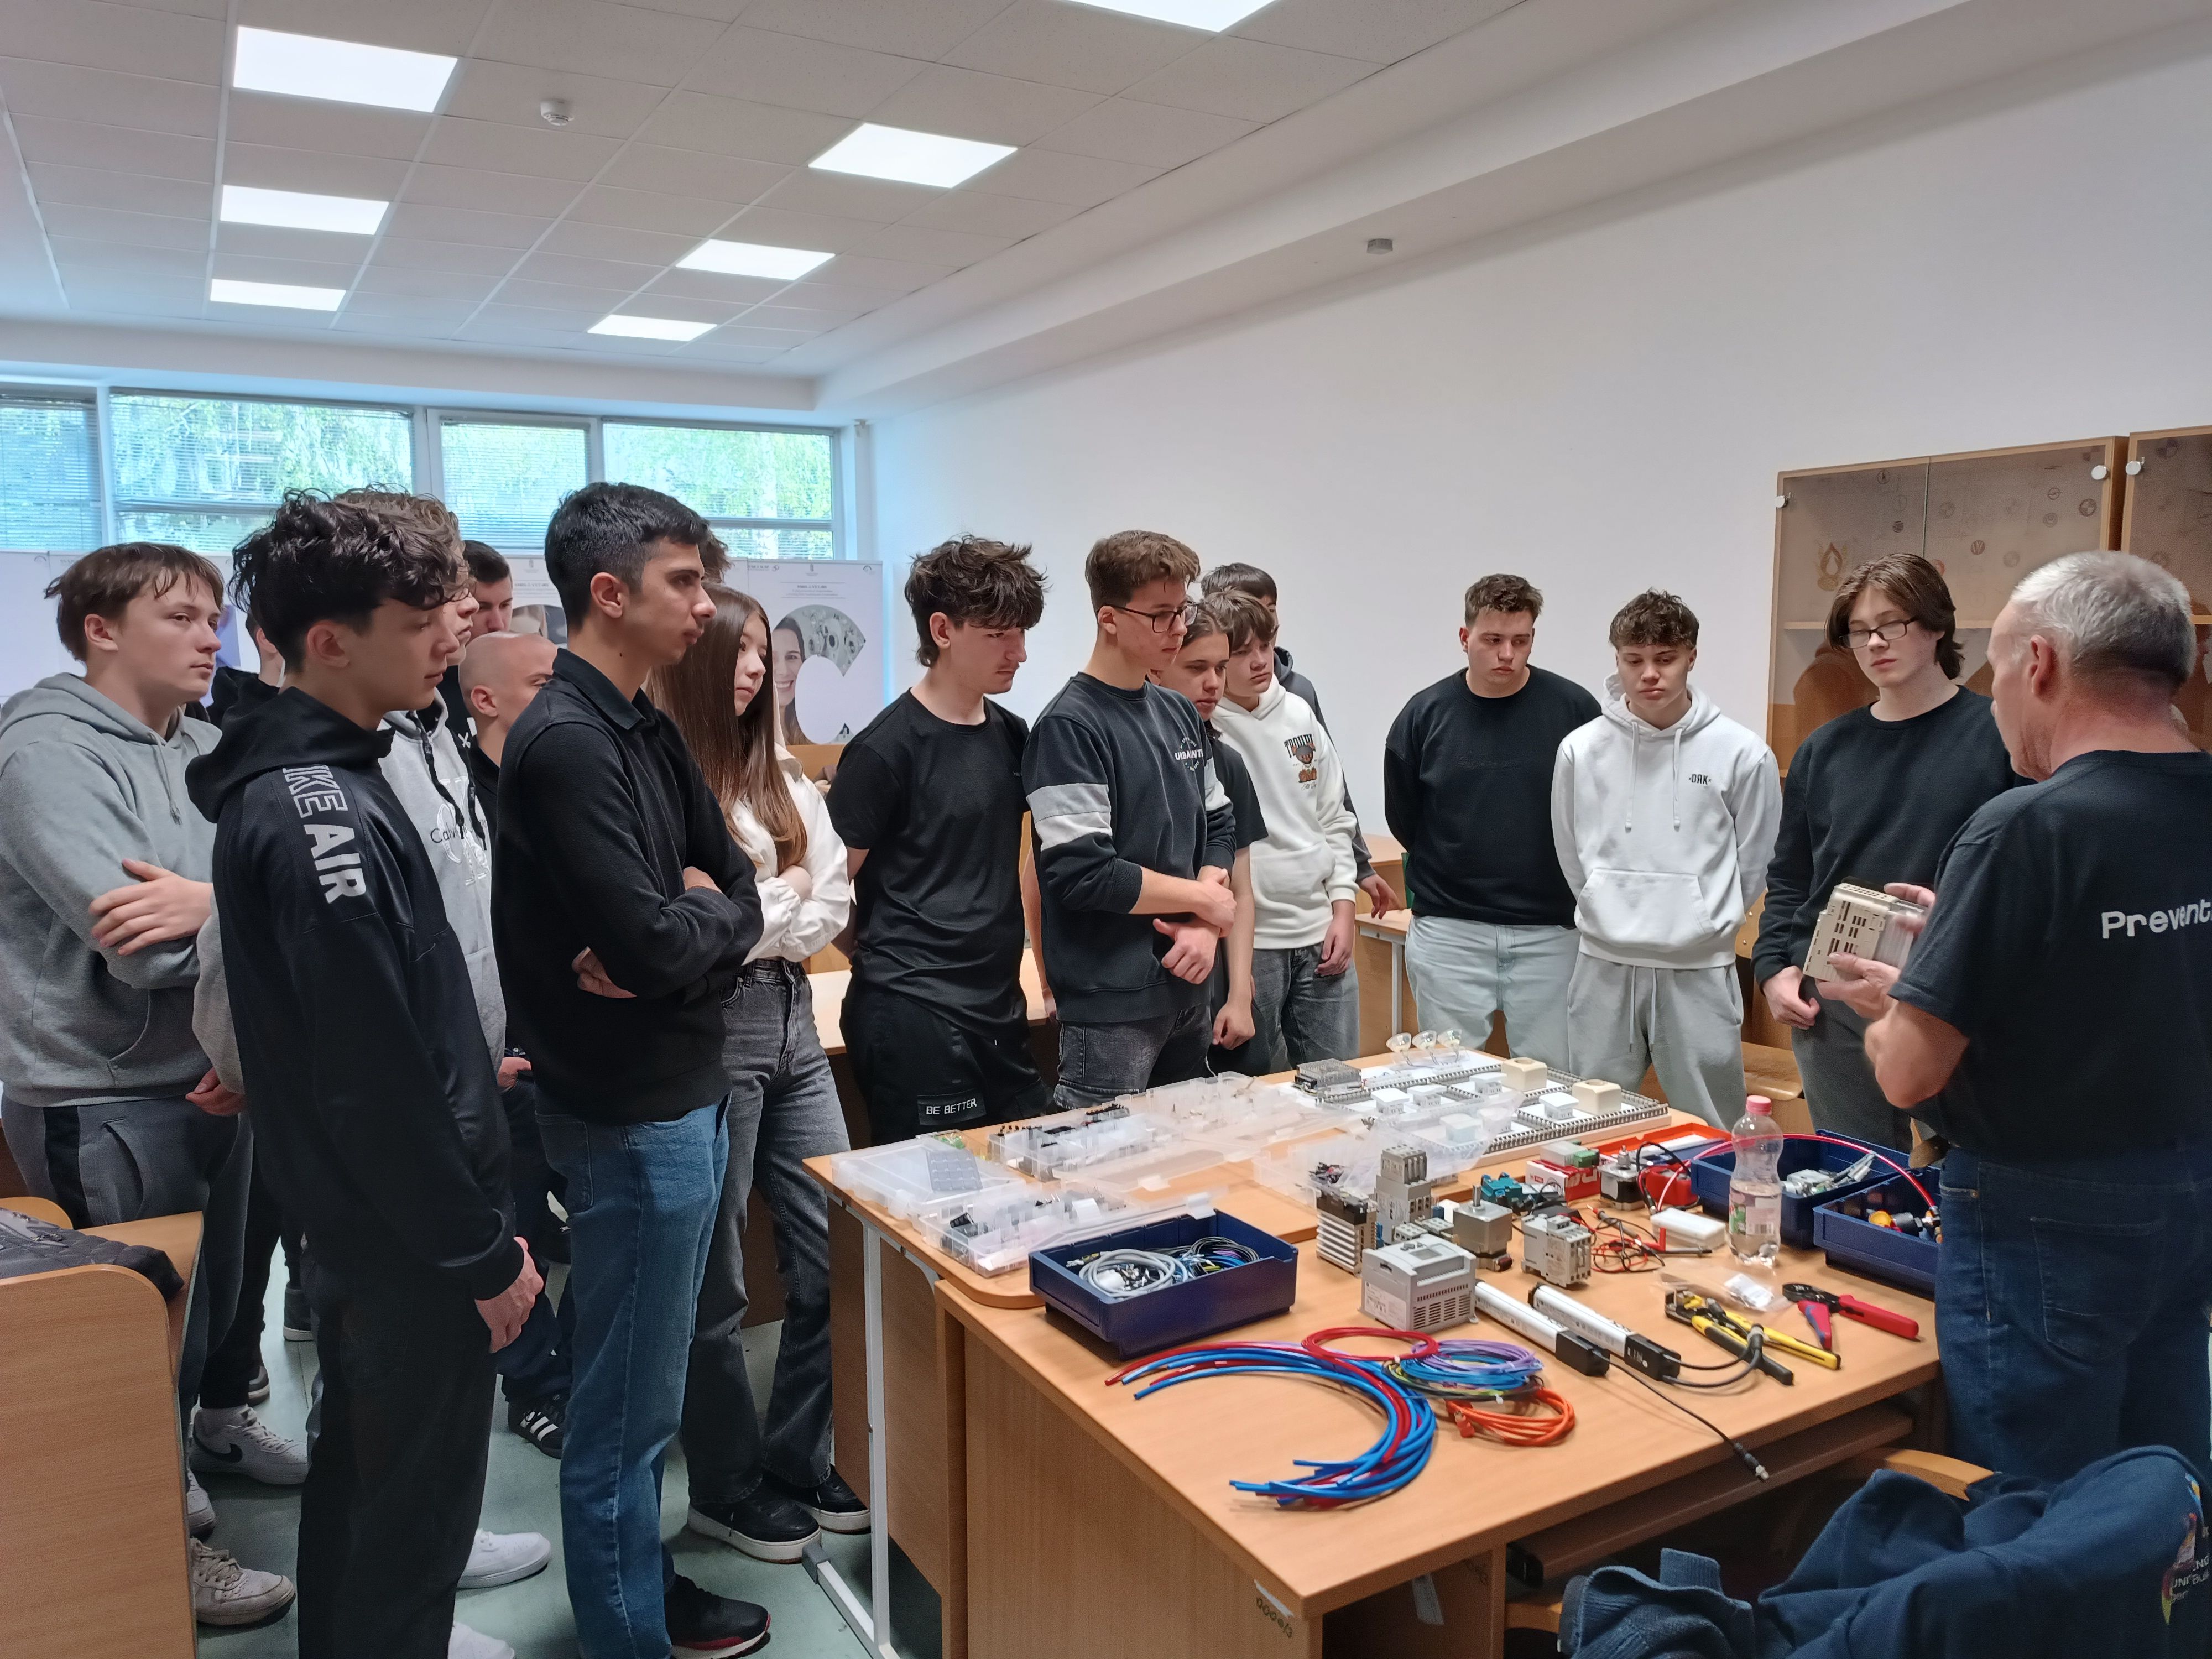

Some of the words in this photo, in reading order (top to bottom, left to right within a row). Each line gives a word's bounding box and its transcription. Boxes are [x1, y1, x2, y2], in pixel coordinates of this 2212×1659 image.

[304, 823, 367, 904] AIR
[2101, 899, 2212, 940] Prevent
[926, 1106, 940, 1115] BE
[944, 1098, 977, 1114] BETTER
